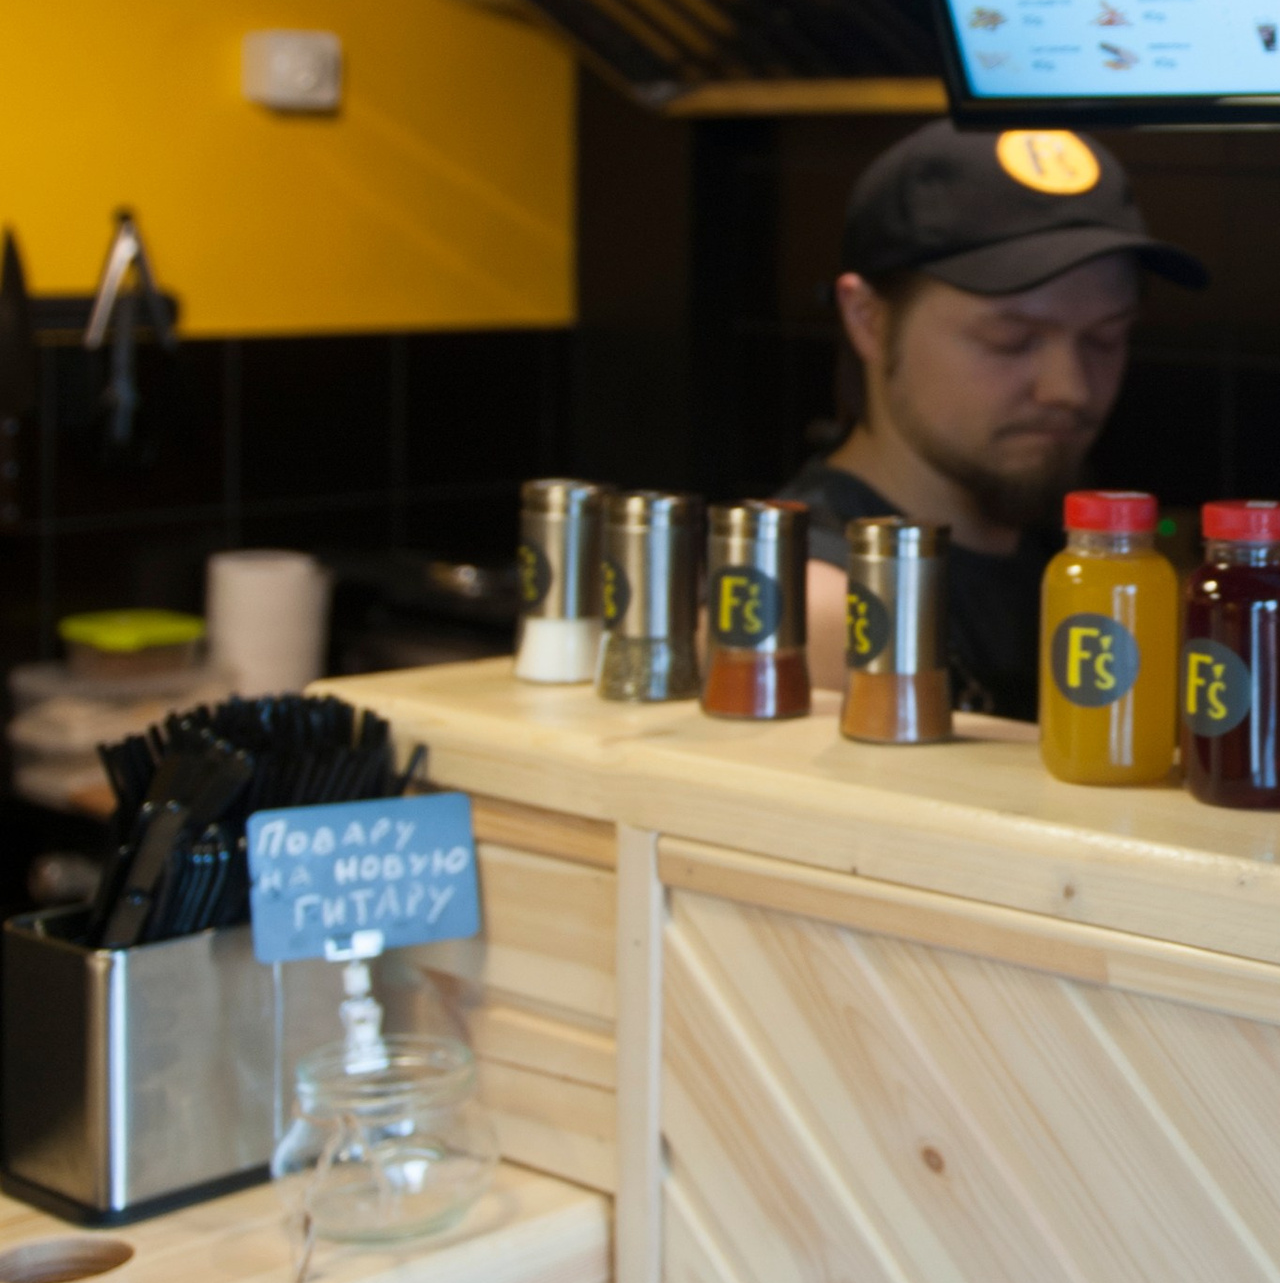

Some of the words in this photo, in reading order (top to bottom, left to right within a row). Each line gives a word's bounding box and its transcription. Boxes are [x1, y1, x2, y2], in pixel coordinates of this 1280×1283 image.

[719, 575, 763, 635] F's
[1066, 626, 1117, 691] F's
[1186, 652, 1230, 721] F's
[256, 817, 417, 859] ПОВАРУ
[258, 864, 313, 893] НА
[334, 845, 471, 886] НОВУЮ
[293, 882, 456, 932] ГИТАРУ
